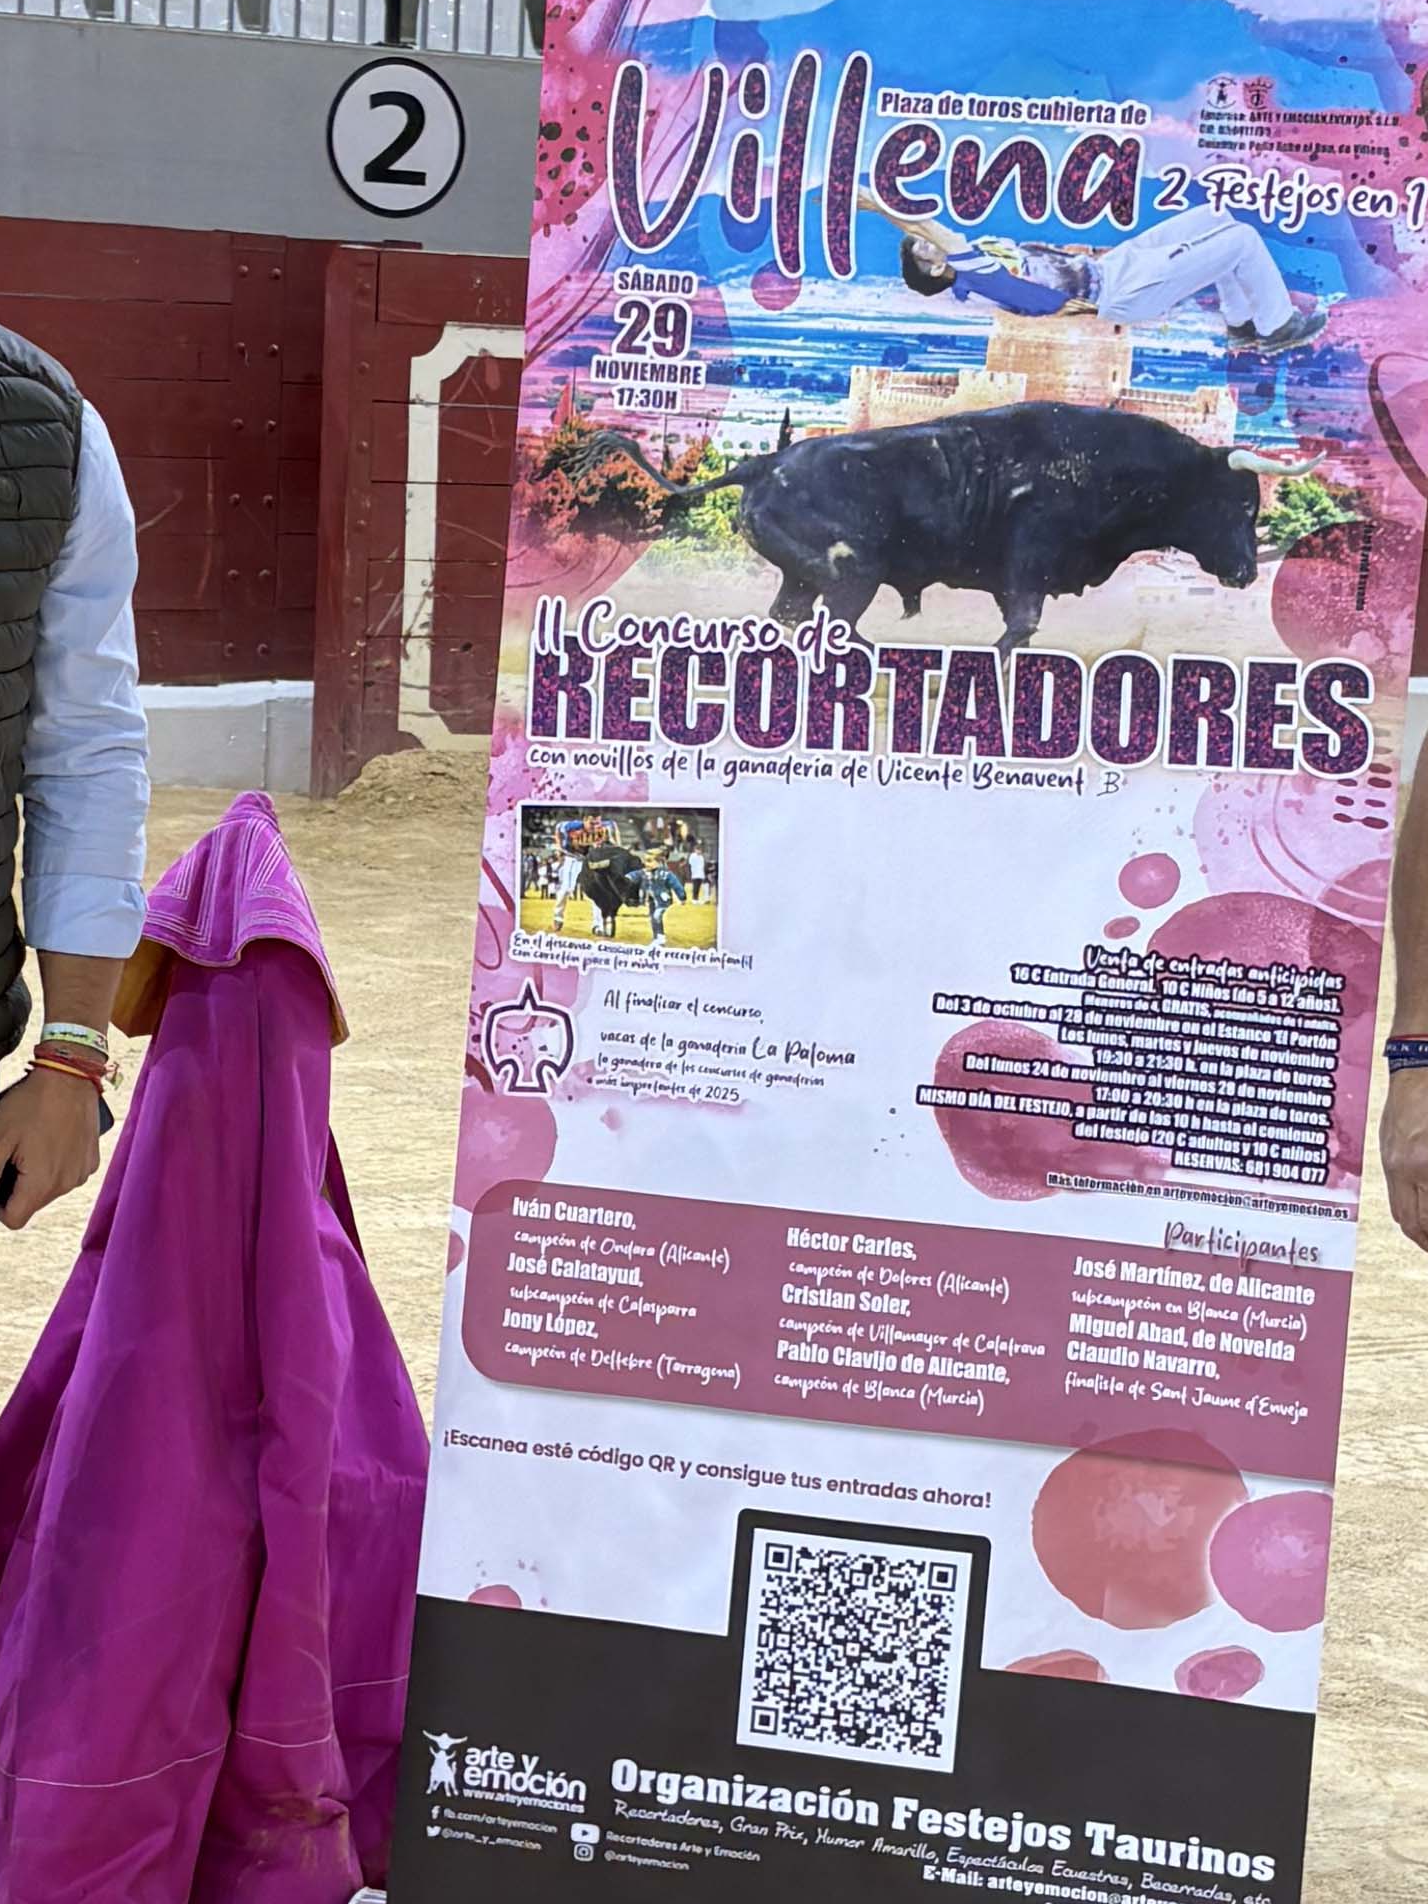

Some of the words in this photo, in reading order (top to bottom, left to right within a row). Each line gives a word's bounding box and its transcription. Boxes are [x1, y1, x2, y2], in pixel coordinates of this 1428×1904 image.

[881, 92, 933, 115] Plaza
[938, 95, 963, 116] de
[968, 98, 1021, 118] toros
[1026, 102, 1116, 124] cubierta
[1122, 104, 1146, 125] de
[363, 91, 427, 186] 2
[610, 51, 1142, 279] Villena
[1158, 167, 1186, 206] 2
[1203, 168, 1340, 229] Festejos
[1353, 190, 1392, 213] en
[1407, 182, 1425, 226] 1
[618, 269, 693, 294] SÁBADO
[616, 300, 687, 358] 29
[595, 360, 702, 385] NOVIEMBRE
[616, 388, 678, 409] 17:30H
[538, 599, 563, 652] II
[581, 599, 780, 653] Concurso
[797, 610, 847, 670] de
[530, 636, 1370, 774] RECORTADORES
[530, 748, 565, 765] con
[573, 747, 653, 776] novillos
[661, 750, 687, 779] de
[696, 749, 715, 779] la
[841, 758, 867, 786] de
[877, 758, 963, 790] Vicente
[972, 762, 1084, 796] Benavent
[1087, 947, 1138, 971] Venta
[1143, 953, 1164, 975] de
[1169, 956, 1244, 984] entradas
[604, 989, 620, 1009] Al
[687, 998, 698, 1016] el
[600, 1031, 636, 1044] vacas
[640, 1033, 656, 1051] de
[662, 1033, 673, 1048] la
[752, 1036, 778, 1060] La
[784, 1041, 856, 1067] Paloma
[1175, 1150, 1244, 1172] RESERVAS:
[1245, 1160, 1270, 1176] 681
[1272, 1164, 1299, 1180] 904
[513, 1196, 550, 1220] Iván
[555, 1202, 637, 1230] Cuartero,
[514, 1231, 576, 1258] campeón
[580, 1236, 596, 1255] de
[600, 1238, 655, 1260] Ondara
[659, 1241, 730, 1275] (Alicante)
[787, 1227, 850, 1253] Héctor
[852, 1233, 917, 1261] Carles,
[1164, 1221, 1319, 1272] Participantes
[507, 1252, 547, 1275] José
[551, 1257, 644, 1287] Calatayud,
[789, 1261, 853, 1286] campeón
[856, 1265, 874, 1286] de
[879, 1267, 932, 1290] Dolores
[936, 1271, 1010, 1304] (Alicante)
[1073, 1256, 1116, 1280] José
[1120, 1261, 1206, 1291] Martínez,
[1210, 1272, 1234, 1294] de
[1236, 1276, 1315, 1305] Alicante
[510, 1285, 594, 1314] subcampeón
[598, 1294, 614, 1314] de
[618, 1295, 697, 1325] Calasparra
[781, 1283, 856, 1310] Cristian
[859, 1291, 912, 1317] Soler,
[1072, 1289, 1161, 1319] subcampeón
[1165, 1303, 1183, 1314] en
[1187, 1301, 1239, 1322] Blanca
[1242, 1305, 1307, 1341] (Murcia)
[502, 1308, 543, 1333] Jony
[545, 1312, 599, 1339] López,
[778, 1317, 843, 1342] campeón
[846, 1322, 865, 1343] de
[869, 1323, 948, 1352] Villamayor
[952, 1333, 970, 1353] de
[974, 1334, 1046, 1356] Calatrava
[1069, 1313, 1135, 1339] Miguel
[1136, 1321, 1189, 1348] Abad,
[1192, 1329, 1216, 1350] de
[1219, 1331, 1296, 1361] Novelda
[505, 1342, 566, 1367] campeón
[570, 1347, 586, 1367] de
[591, 1349, 653, 1370] Deltebre
[657, 1354, 741, 1390] (Tarragona)
[777, 1339, 829, 1364] Pablo
[833, 1346, 898, 1373] Clavijo
[901, 1353, 925, 1374] de
[927, 1356, 1011, 1385] Alicante,
[1066, 1340, 1140, 1367] Claudio
[1143, 1350, 1221, 1380] Navarro,
[774, 1373, 838, 1399] campeón
[842, 1378, 860, 1400] de
[864, 1380, 916, 1401] Blanca
[919, 1383, 984, 1416] (Murcia)
[1065, 1371, 1124, 1395] finalista
[1128, 1380, 1146, 1400] de
[1150, 1382, 1188, 1406] Sant
[1191, 1387, 1241, 1408] Jaume
[443, 1428, 528, 1455] ¡Escanea
[532, 1441, 573, 1459] esté
[577, 1445, 644, 1471] código
[648, 1454, 675, 1473] QR
[679, 1460, 692, 1479] y
[695, 1461, 786, 1488] consigue
[791, 1471, 822, 1490] tus
[826, 1477, 918, 1501] entradas
[922, 1487, 992, 1509] ahora!
[464, 1745, 515, 1770] arte
[522, 1753, 539, 1776] y
[463, 1766, 587, 1801] emoción
[610, 1758, 880, 1827] Organización
[891, 1796, 1072, 1853] Festejos
[1084, 1820, 1276, 1882] Taurinos
[613, 1798, 724, 1834] Recortadores,
[730, 1816, 769, 1837] Gran
[774, 1820, 809, 1846] Prix,
[814, 1827, 865, 1850] Humor
[871, 1836, 940, 1864] Amarillo,
[923, 1866, 984, 1889] E-Mail:
